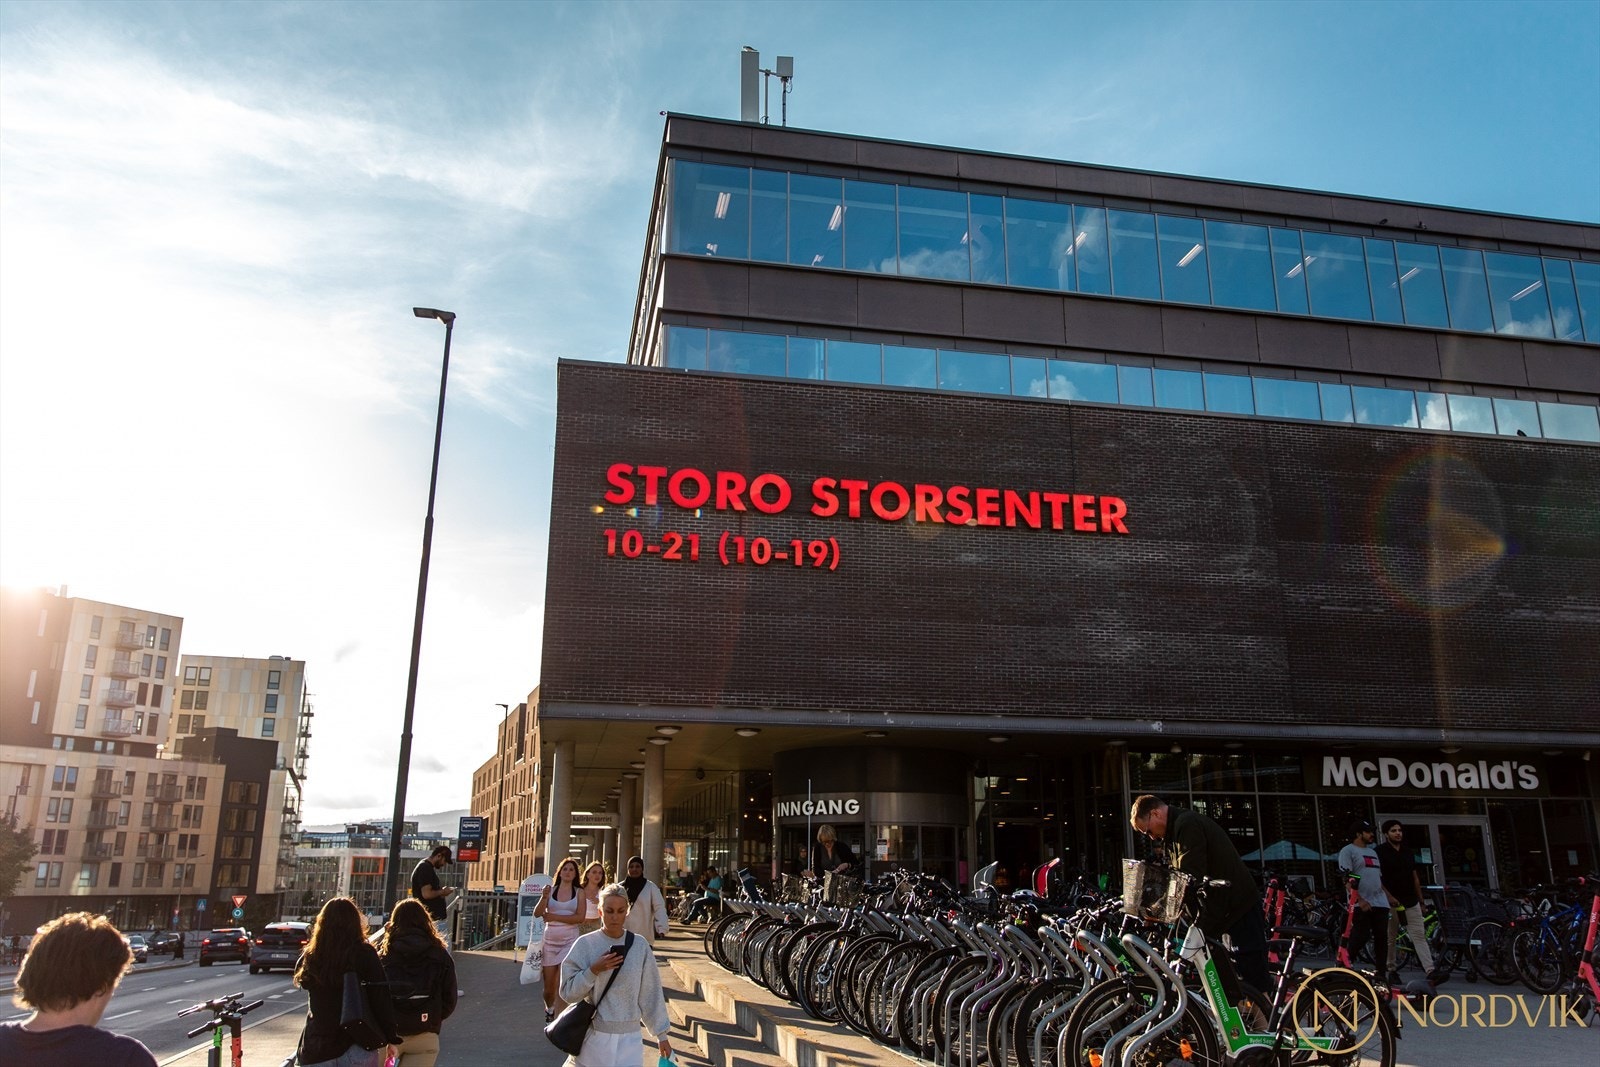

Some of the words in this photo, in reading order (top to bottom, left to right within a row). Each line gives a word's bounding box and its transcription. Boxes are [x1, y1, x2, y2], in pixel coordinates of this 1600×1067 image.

[604, 462, 792, 516] STORO
[811, 477, 1129, 535] STORSENTER
[603, 528, 701, 562] 10-21
[718, 531, 841, 571] (10-19)
[1322, 755, 1540, 791] McDonald's
[777, 798, 860, 818] INNGANG
[1207, 970, 1217, 988] Oslo
[1213, 987, 1229, 1022] kommune
